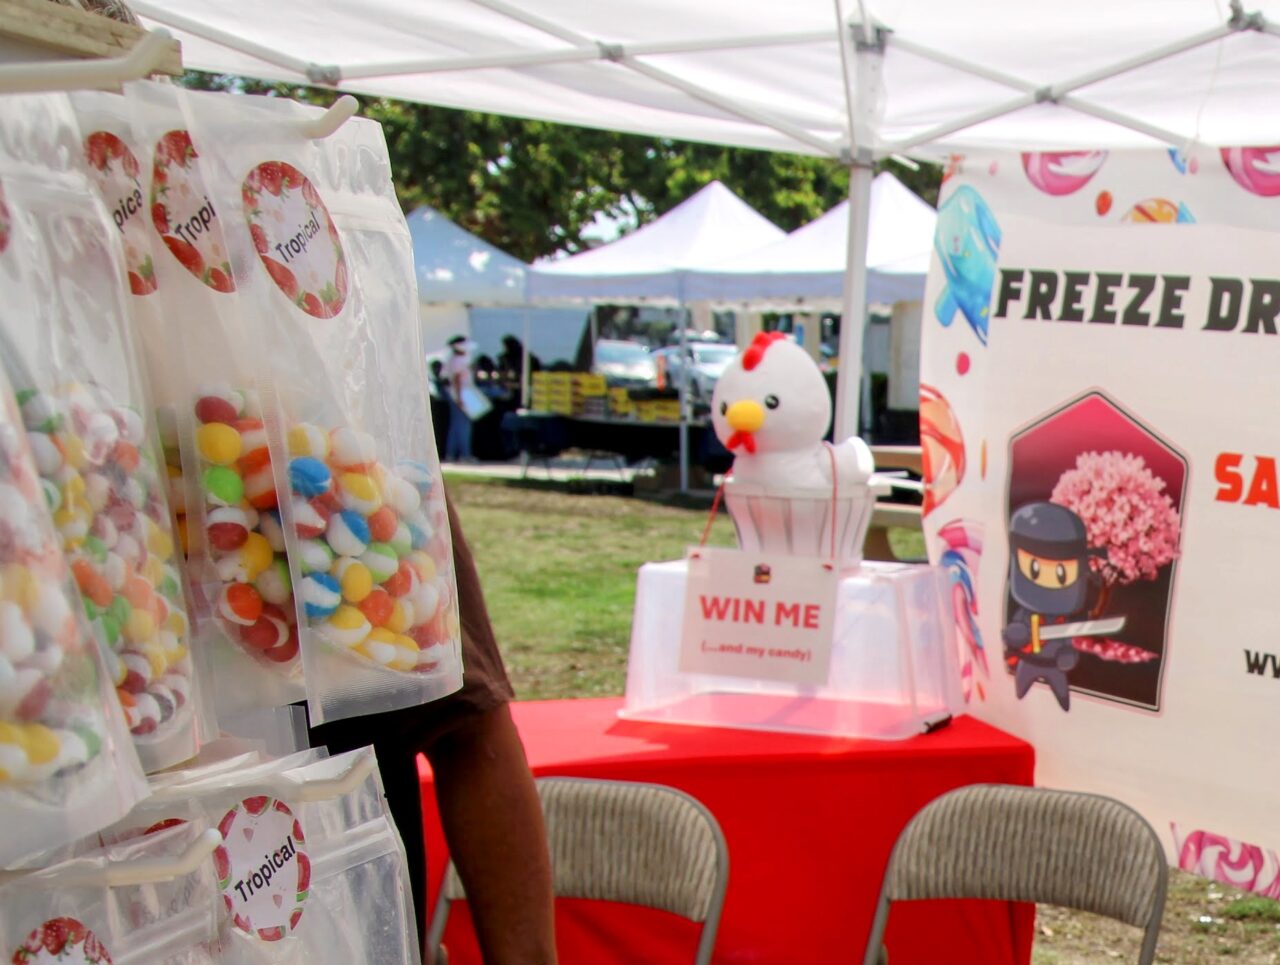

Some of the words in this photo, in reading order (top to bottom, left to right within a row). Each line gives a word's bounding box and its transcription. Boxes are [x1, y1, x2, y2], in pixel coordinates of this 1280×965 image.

[174, 195, 217, 247] Tropi
[275, 211, 321, 264] Tropical
[992, 268, 1191, 329] FREEZE
[699, 595, 766, 625] WIN
[775, 602, 821, 630] ME
[746, 645, 765, 658] my
[768, 647, 812, 662] candy)
[233, 835, 297, 903] Tropical
